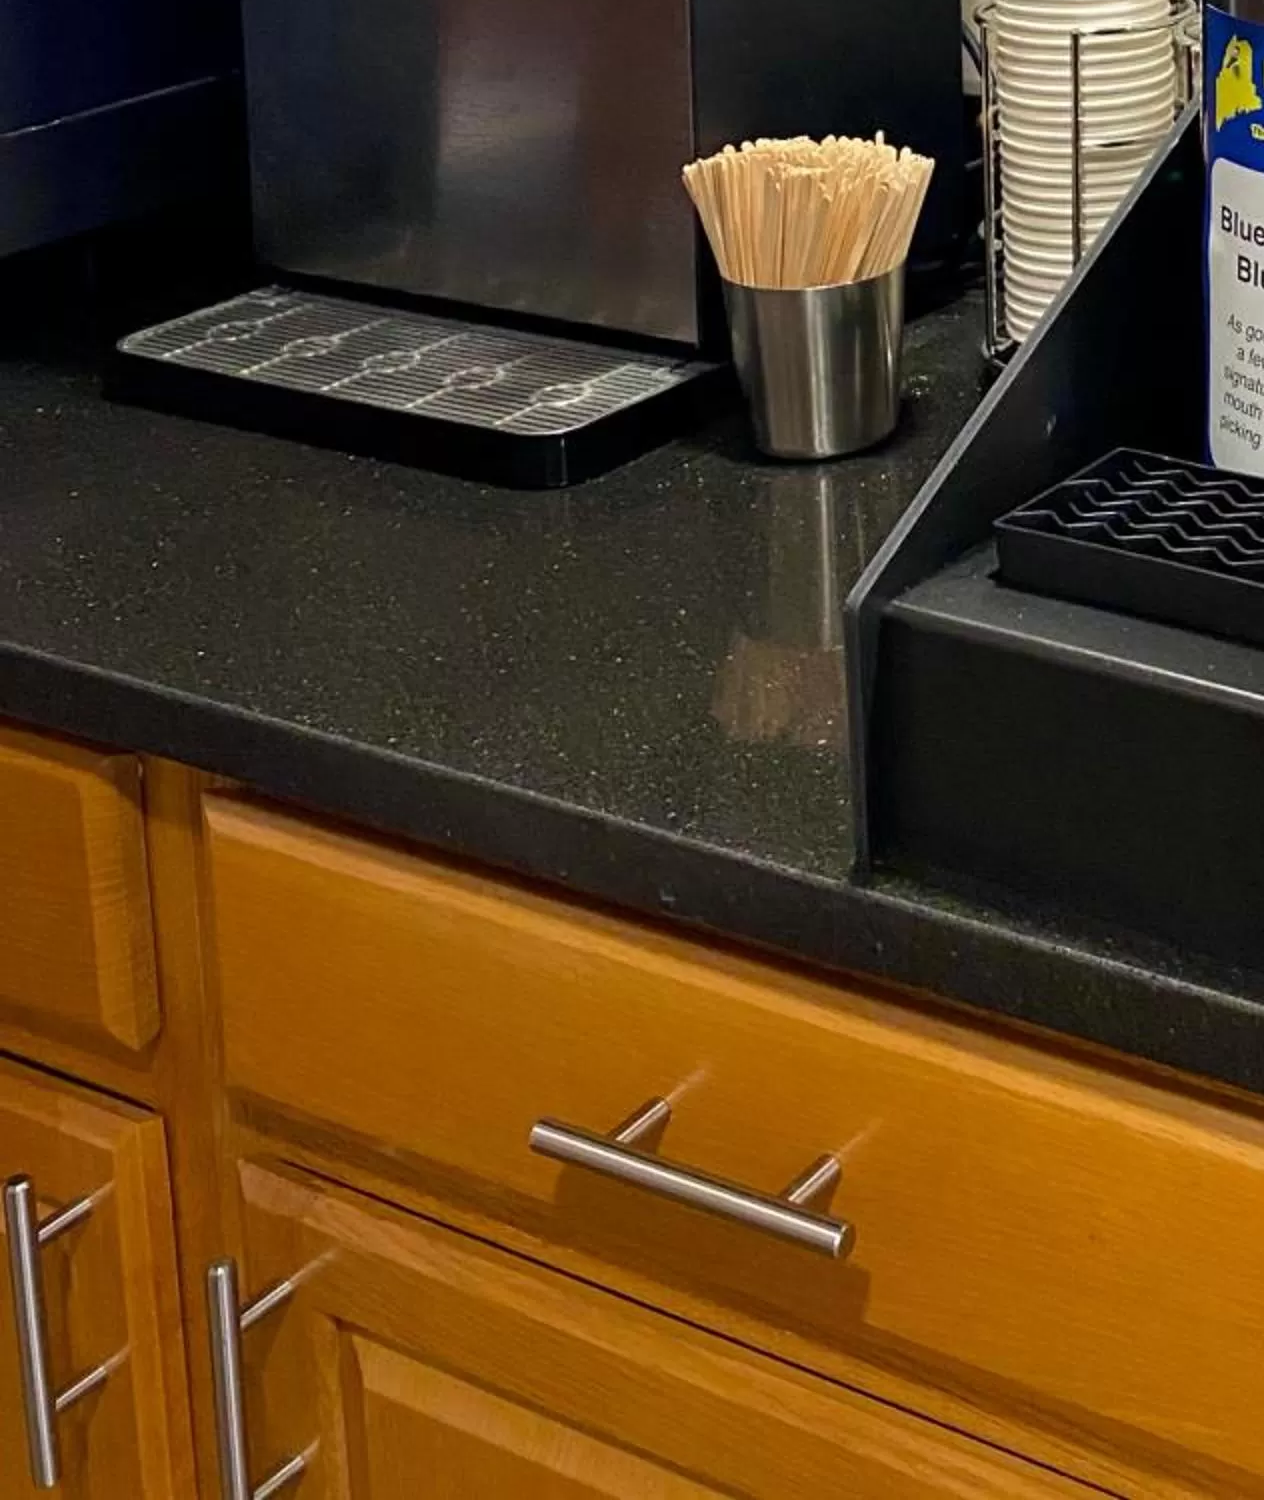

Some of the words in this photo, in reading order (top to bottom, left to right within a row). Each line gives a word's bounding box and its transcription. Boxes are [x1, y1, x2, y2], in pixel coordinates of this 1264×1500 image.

[1227, 313, 1243, 334] As
[1236, 347, 1245, 361] a
[1223, 391, 1262, 420] mouth
